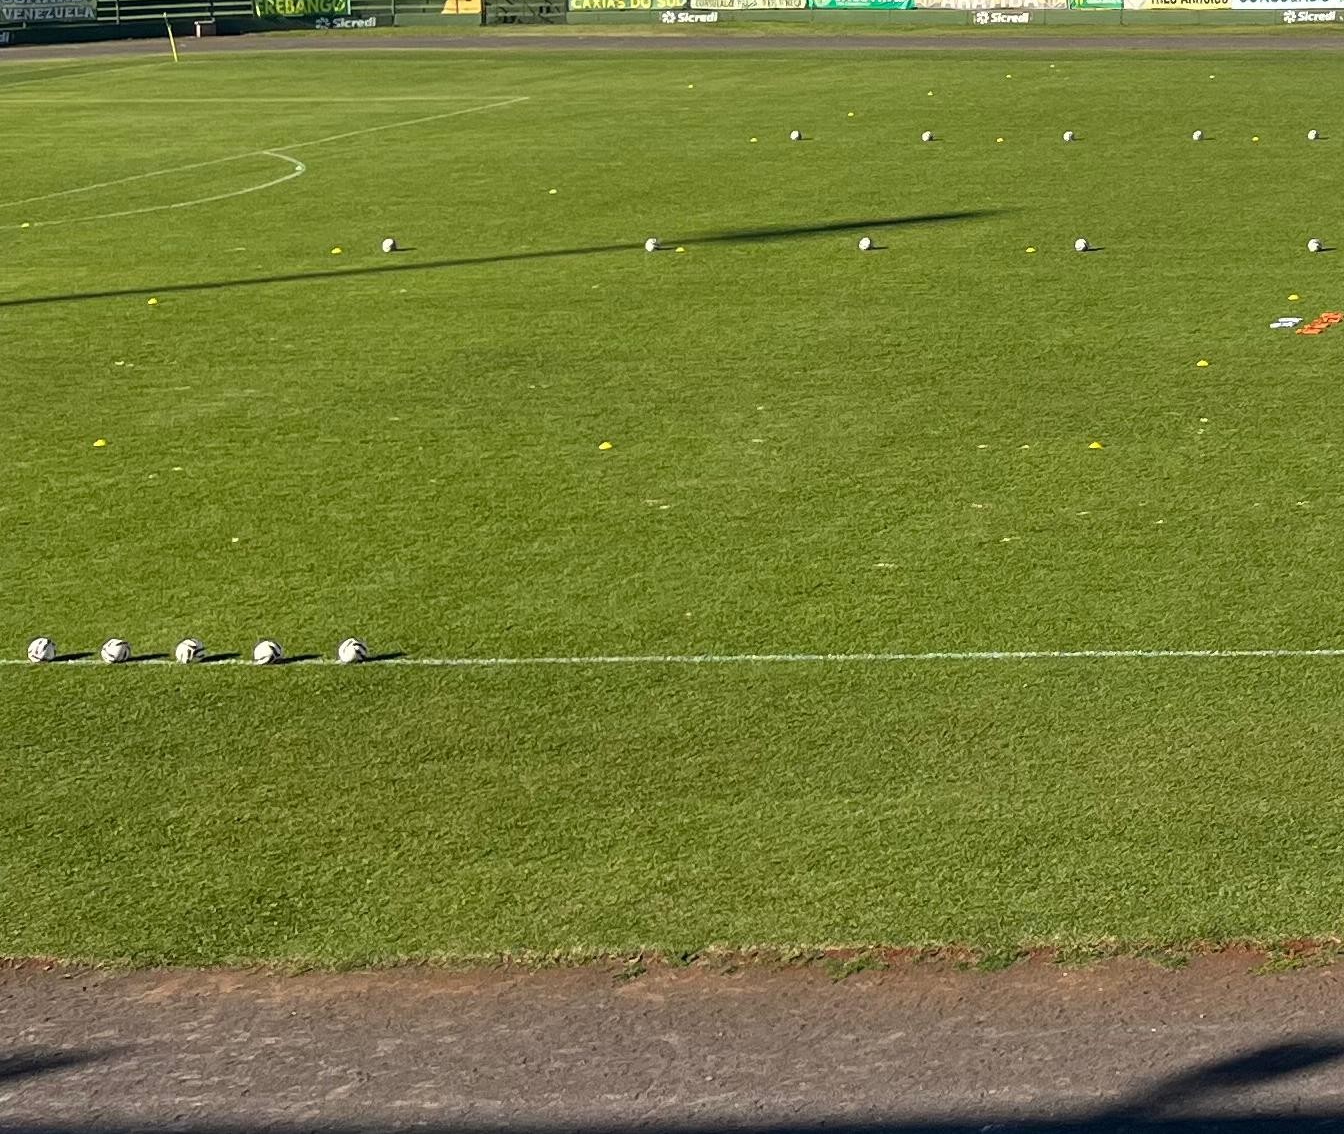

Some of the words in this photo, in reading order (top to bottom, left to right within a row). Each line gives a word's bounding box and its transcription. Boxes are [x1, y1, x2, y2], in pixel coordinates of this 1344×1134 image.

[2, 6, 95, 20] VENEZUELA
[677, 12, 718, 23] Sicredi
[990, 12, 1030, 24] Sicredi
[1297, 11, 1336, 22] Sicredi
[332, 17, 376, 29] Sicredi
